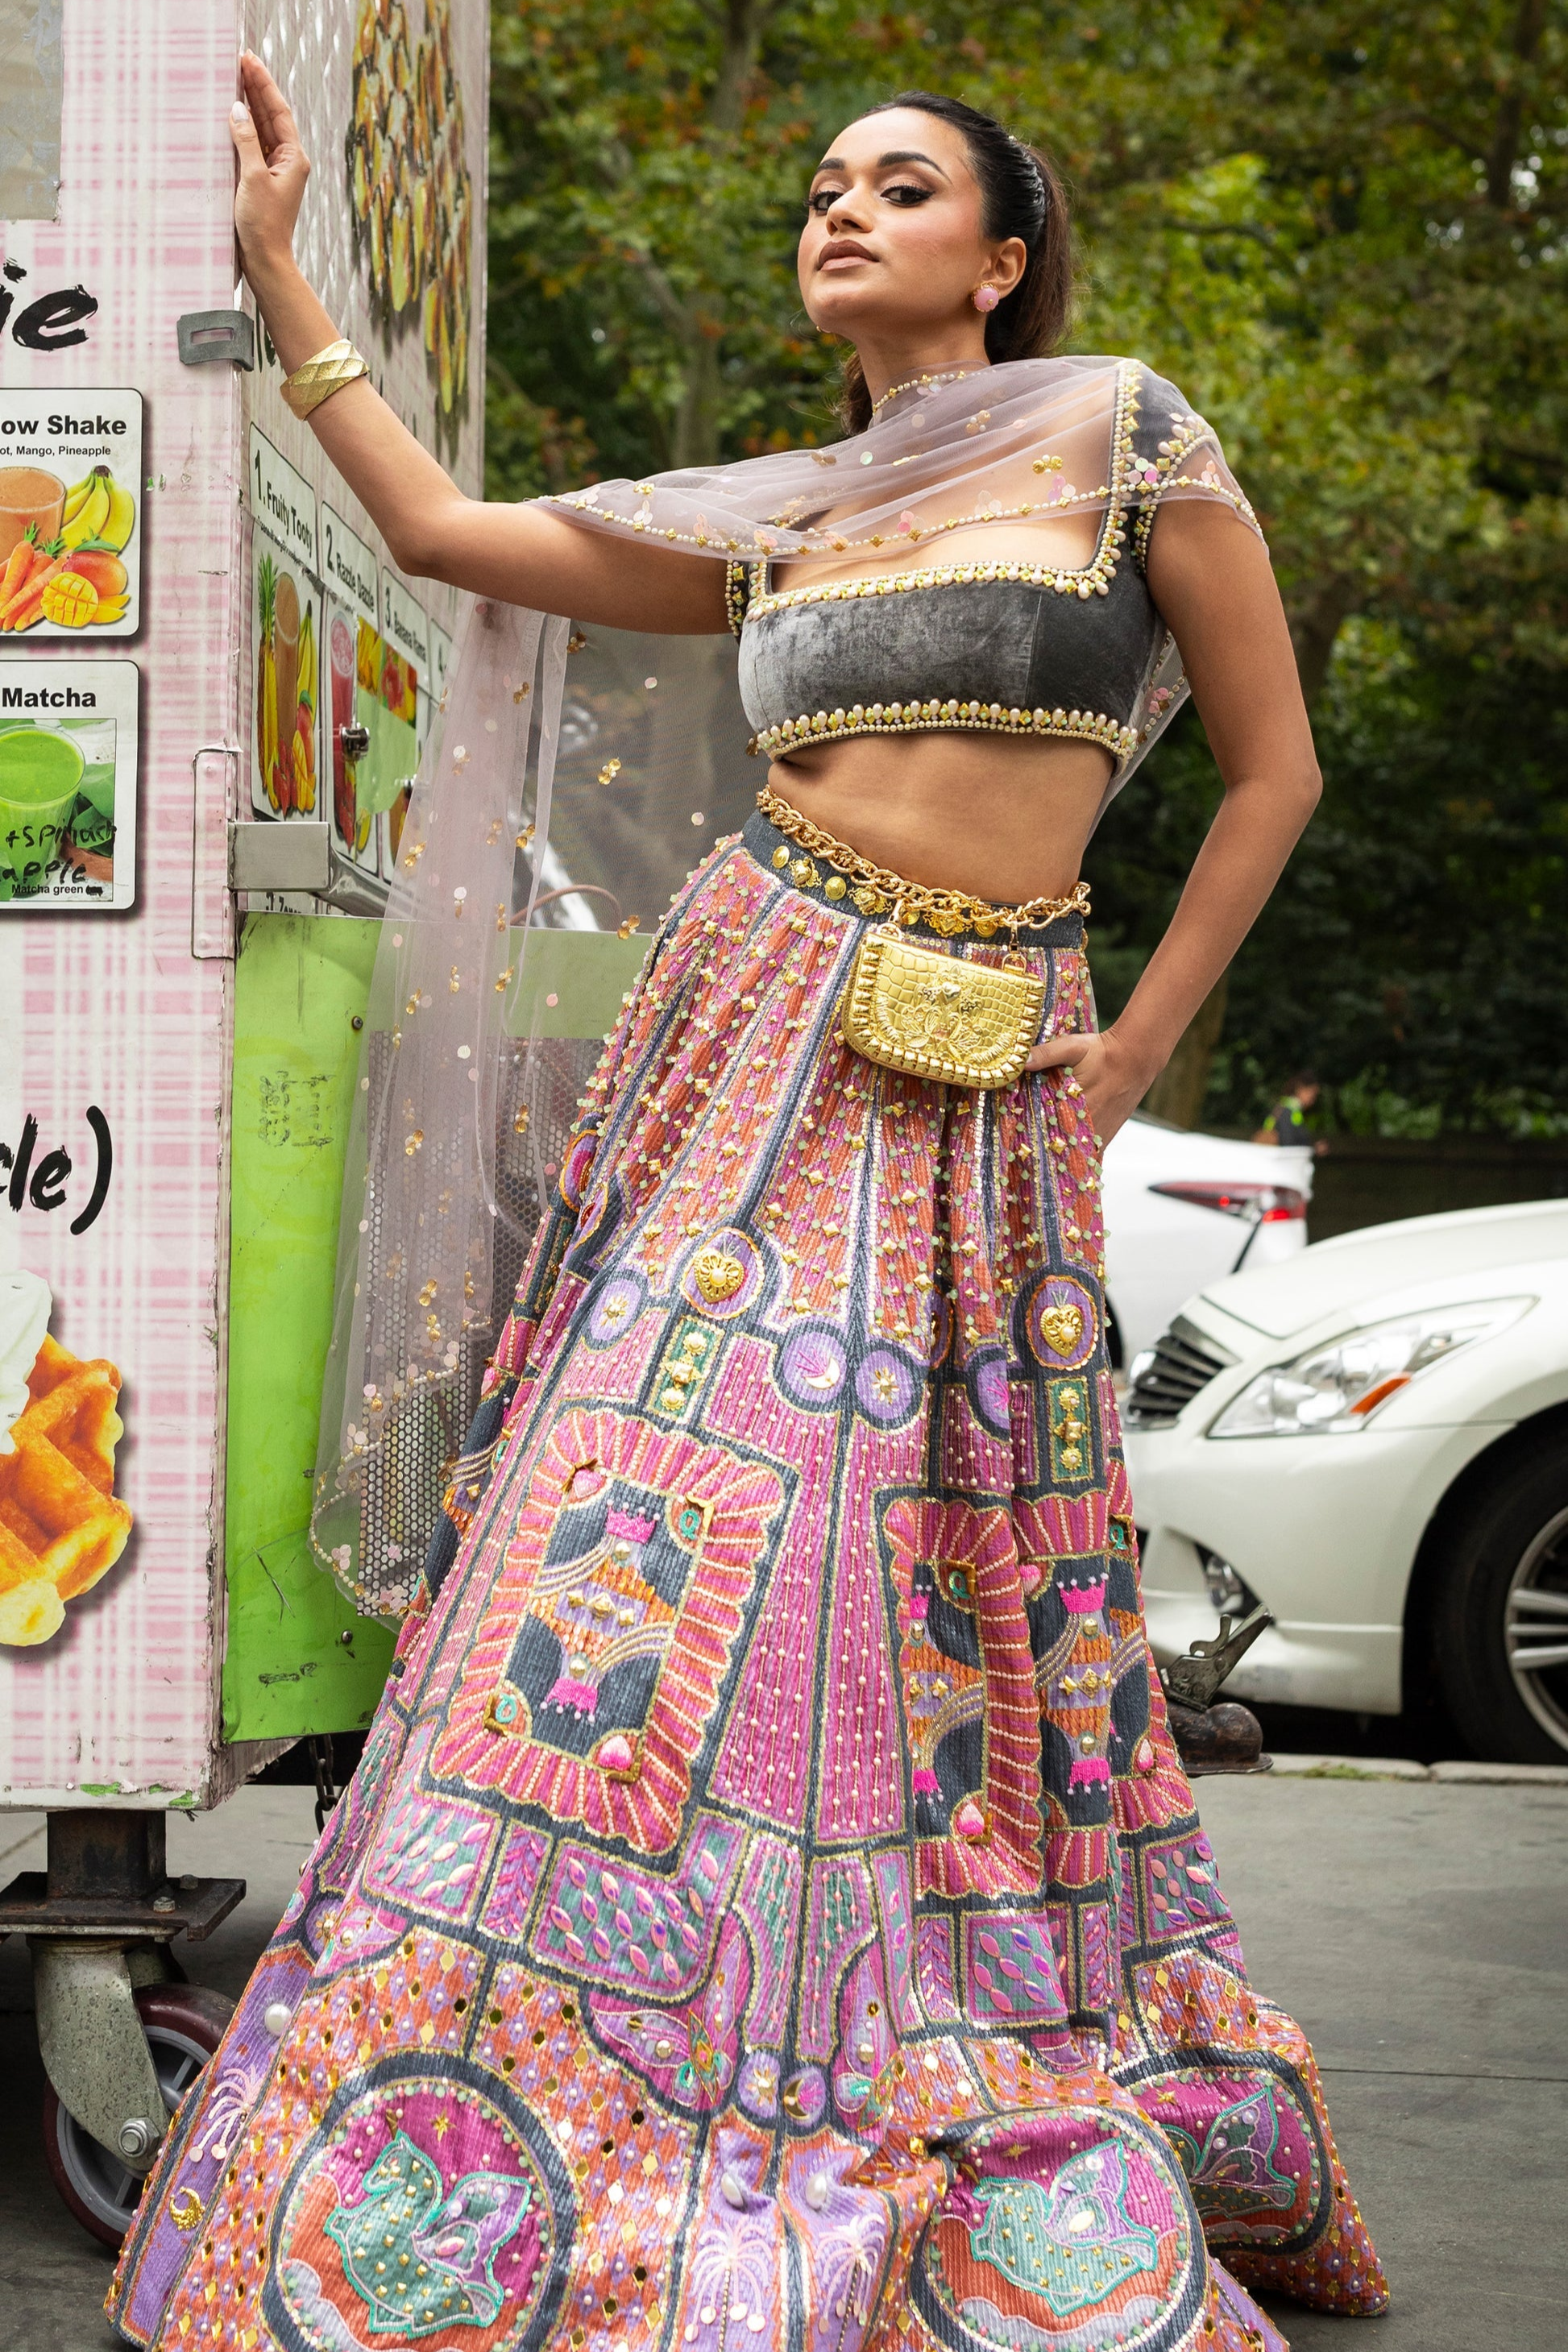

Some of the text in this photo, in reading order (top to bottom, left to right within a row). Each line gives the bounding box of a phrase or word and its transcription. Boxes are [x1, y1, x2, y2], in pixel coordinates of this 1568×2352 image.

[2, 415, 127, 435] ow Shake
[16, 446, 55, 457] Mango,
[58, 446, 111, 457] Pineapple
[267, 480, 289, 536] Fruity
[291, 506, 312, 558] Tooty
[2, 687, 96, 707] Matcha
[12, 884, 50, 894] Matcha
[53, 886, 83, 895] green
